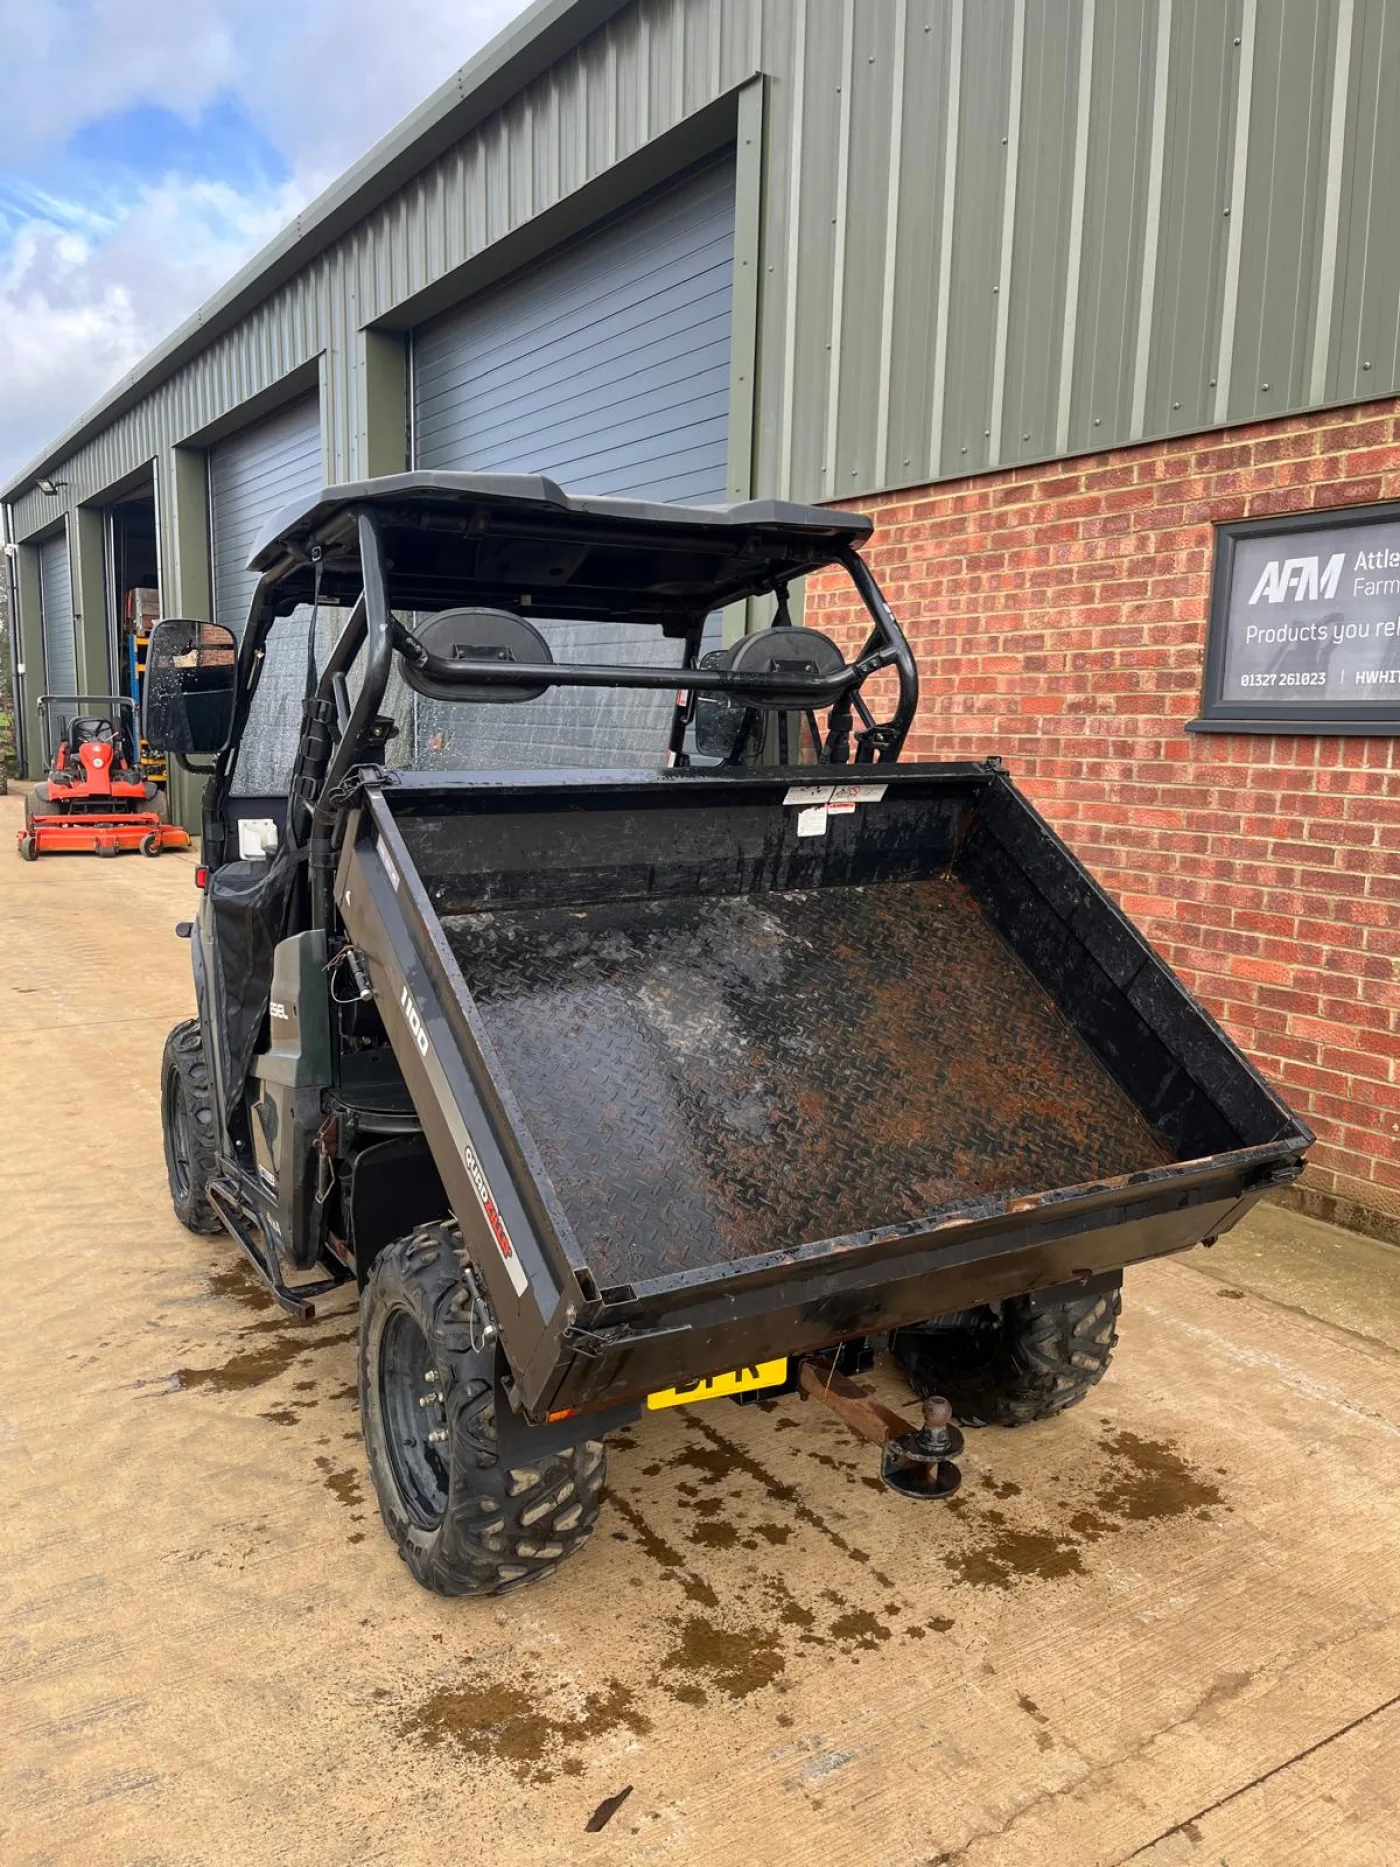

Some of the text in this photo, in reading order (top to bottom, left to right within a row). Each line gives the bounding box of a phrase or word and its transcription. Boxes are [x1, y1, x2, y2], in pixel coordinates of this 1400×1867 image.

[1247, 553, 1345, 604] AFM
[1353, 577, 1400, 597] Farm
[1246, 623, 1329, 644] Products
[1333, 623, 1370, 644] you
[1240, 674, 1277, 687] 01327
[1279, 672, 1326, 686] 261023
[401, 986, 428, 1056] 1100
